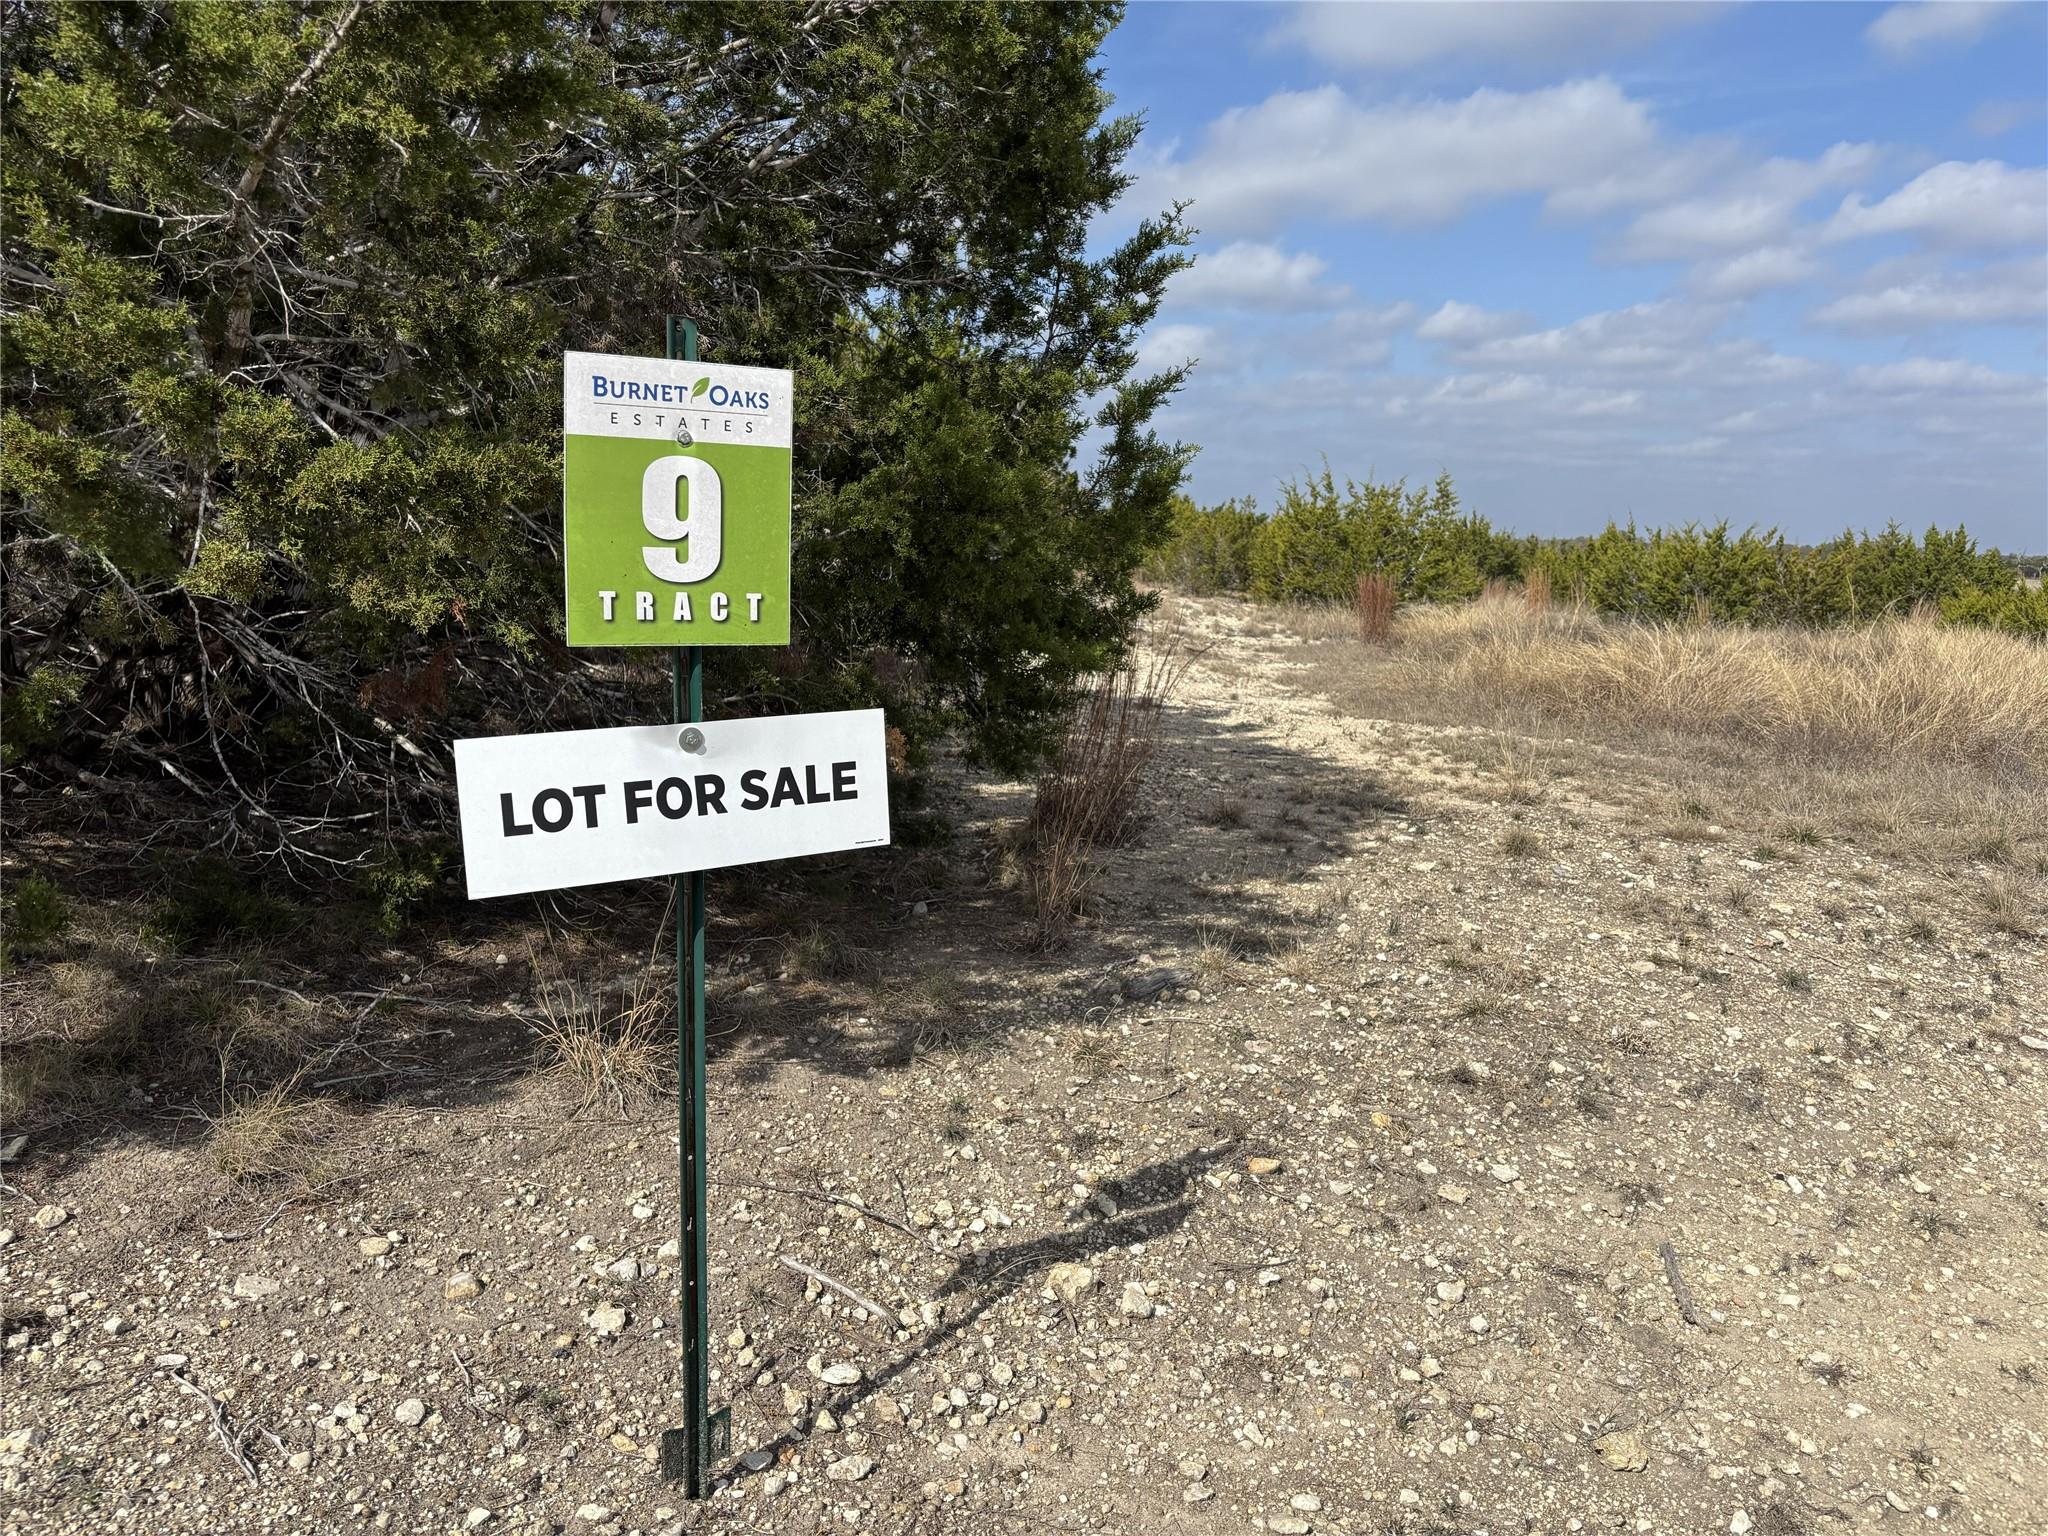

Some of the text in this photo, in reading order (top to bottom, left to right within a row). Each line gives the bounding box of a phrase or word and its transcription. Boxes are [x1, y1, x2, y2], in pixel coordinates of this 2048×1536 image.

[592, 375, 770, 410] BURNET OAKS
[610, 411, 754, 433] ESTATES
[641, 455, 723, 584] 9
[598, 590, 763, 622] TRACT
[499, 760, 859, 837] LOT FOR SALE
